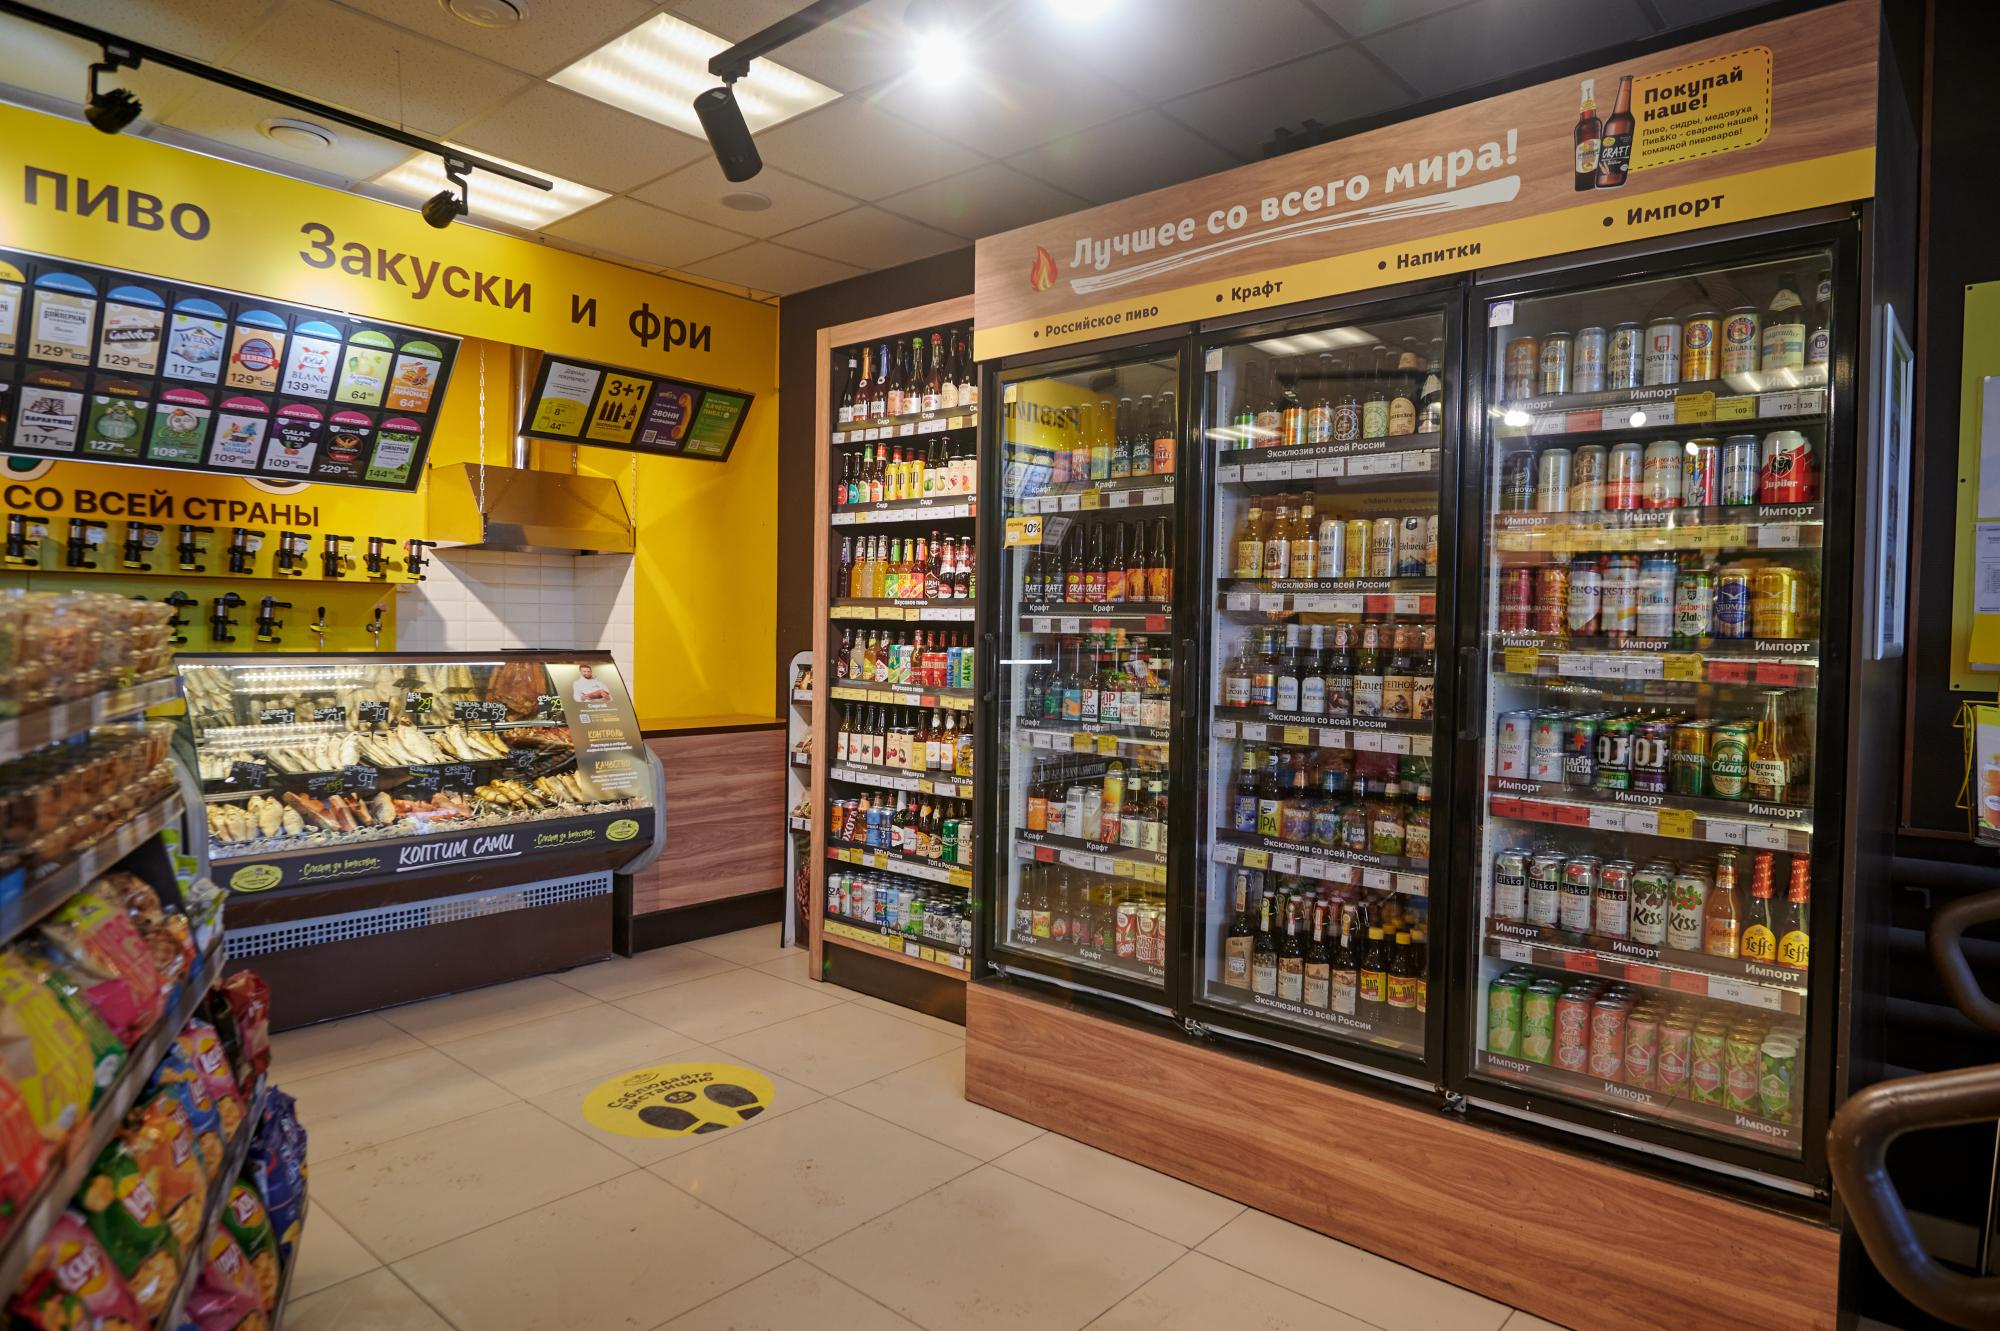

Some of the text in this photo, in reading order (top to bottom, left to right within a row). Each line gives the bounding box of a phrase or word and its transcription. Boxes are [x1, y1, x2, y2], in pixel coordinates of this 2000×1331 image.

[1643, 66, 1743, 105] Покупай
[1643, 93, 1708, 122] наше!
[1642, 105, 1753, 138] Пиво, сидры, медовуха
[1642, 113, 1759, 147] Пив&Ко сварено нашей
[1642, 128, 1743, 157] командой пивоваров!
[1070, 128, 1519, 270] Лучшее со всего мира!
[1627, 194, 1725, 226] Импорт
[1397, 242, 1481, 270] Напитки
[299, 222, 532, 313] Закуски
[571, 294, 597, 328] и
[628, 303, 712, 353] фри
[1231, 279, 1283, 304] Крафт
[1045, 303, 1159, 338] Российское пиво
[179, 332, 216, 347] WEISS
[34, 343, 64, 357] 129
[104, 353, 130, 367] 129
[1646, 353, 1680, 363] SPATEN
[172, 363, 195, 376] 117
[231, 373, 256, 385] 129
[292, 371, 329, 384] BLANC
[1766, 373, 1822, 386] Импорт
[287, 380, 309, 392] 139
[608, 380, 646, 400] 3+1
[351, 390, 367, 400] 64
[1630, 387, 1680, 400] Импорт
[399, 398, 414, 407] 64
[705, 403, 738, 414] КАЧЕСТВО
[1779, 403, 1792, 411] 179
[652, 409, 680, 419] ЗВОНИ
[1734, 407, 1748, 415] 109
[550, 422, 561, 431] 44
[23, 434, 48, 444] 117
[90, 440, 115, 450] 127
[153, 447, 178, 457] 109
[1266, 447, 1314, 458] Эксклюзив
[1328, 445, 1350, 453] всей
[1351, 441, 1386, 450] России
[214, 454, 237, 463] 109
[268, 458, 290, 468] 109
[319, 464, 341, 474] 229
[369, 469, 388, 478] 144
[1031, 486, 1052, 495] Крафт
[1095, 480, 1117, 489] Крафт
[1764, 479, 1799, 490] Jupiler
[4, 484, 319, 527] СО ВСЕЙ СТРАНЫ
[1759, 506, 1815, 517] Импорт
[1504, 516, 1549, 526] Импорт
[1624, 511, 1672, 522] Импорт
[1024, 523, 1041, 534] 10%
[1271, 581, 1319, 589] Эксклюзив
[1333, 581, 1355, 589] всей
[1356, 581, 1391, 589] России
[1029, 604, 1050, 612] Крафт
[1092, 604, 1115, 613] Крафт
[1502, 637, 1546, 648] Импорт
[1620, 639, 1669, 650] Импорт
[1755, 640, 1810, 654] Импорт
[417, 697, 431, 712] 29
[465, 708, 479, 719] 66
[491, 709, 506, 721] 59
[1020, 718, 1041, 727] Крафт
[1268, 712, 1387, 728] Эксклюзив со всей России
[1082, 722, 1104, 732] Крафт
[588, 729, 624, 738] КОНТРОЛЬ
[846, 762, 868, 770] Медовуха
[1566, 757, 1592, 766] LAPIN
[1711, 760, 1748, 775] Chang
[1750, 761, 1782, 771] Corona
[902, 770, 925, 778] Медовуха
[1566, 764, 1592, 774] KULTA
[1498, 780, 1542, 792] Импорт
[1615, 791, 1664, 806] Импорт
[1748, 803, 1804, 819] Импорт
[1260, 814, 1277, 831] IPA
[1023, 831, 1044, 841] Крафт
[1086, 842, 1109, 852] Крафт
[1263, 838, 1380, 863] Эксклюзив со всей России
[927, 859, 938, 867] ТОП
[1633, 906, 1662, 925] Kiss
[1670, 912, 1697, 931] Kiss
[1495, 921, 1539, 938] Импорт
[1017, 933, 1038, 944] Крафт
[1613, 941, 1661, 958] Импорт
[1746, 936, 1773, 956] Leffe
[1079, 948, 1101, 960] Крафт
[1745, 963, 1800, 982] Импорт
[1254, 995, 1372, 1031] Эксклюзив со всей России
[1488, 1055, 1531, 1072] Импорт
[607, 1071, 713, 1109] Соблюдайте
[622, 1076, 714, 1110] дистанцию
[1604, 1082, 1652, 1102] Импорт
[1735, 1114, 1789, 1137] Импорт
